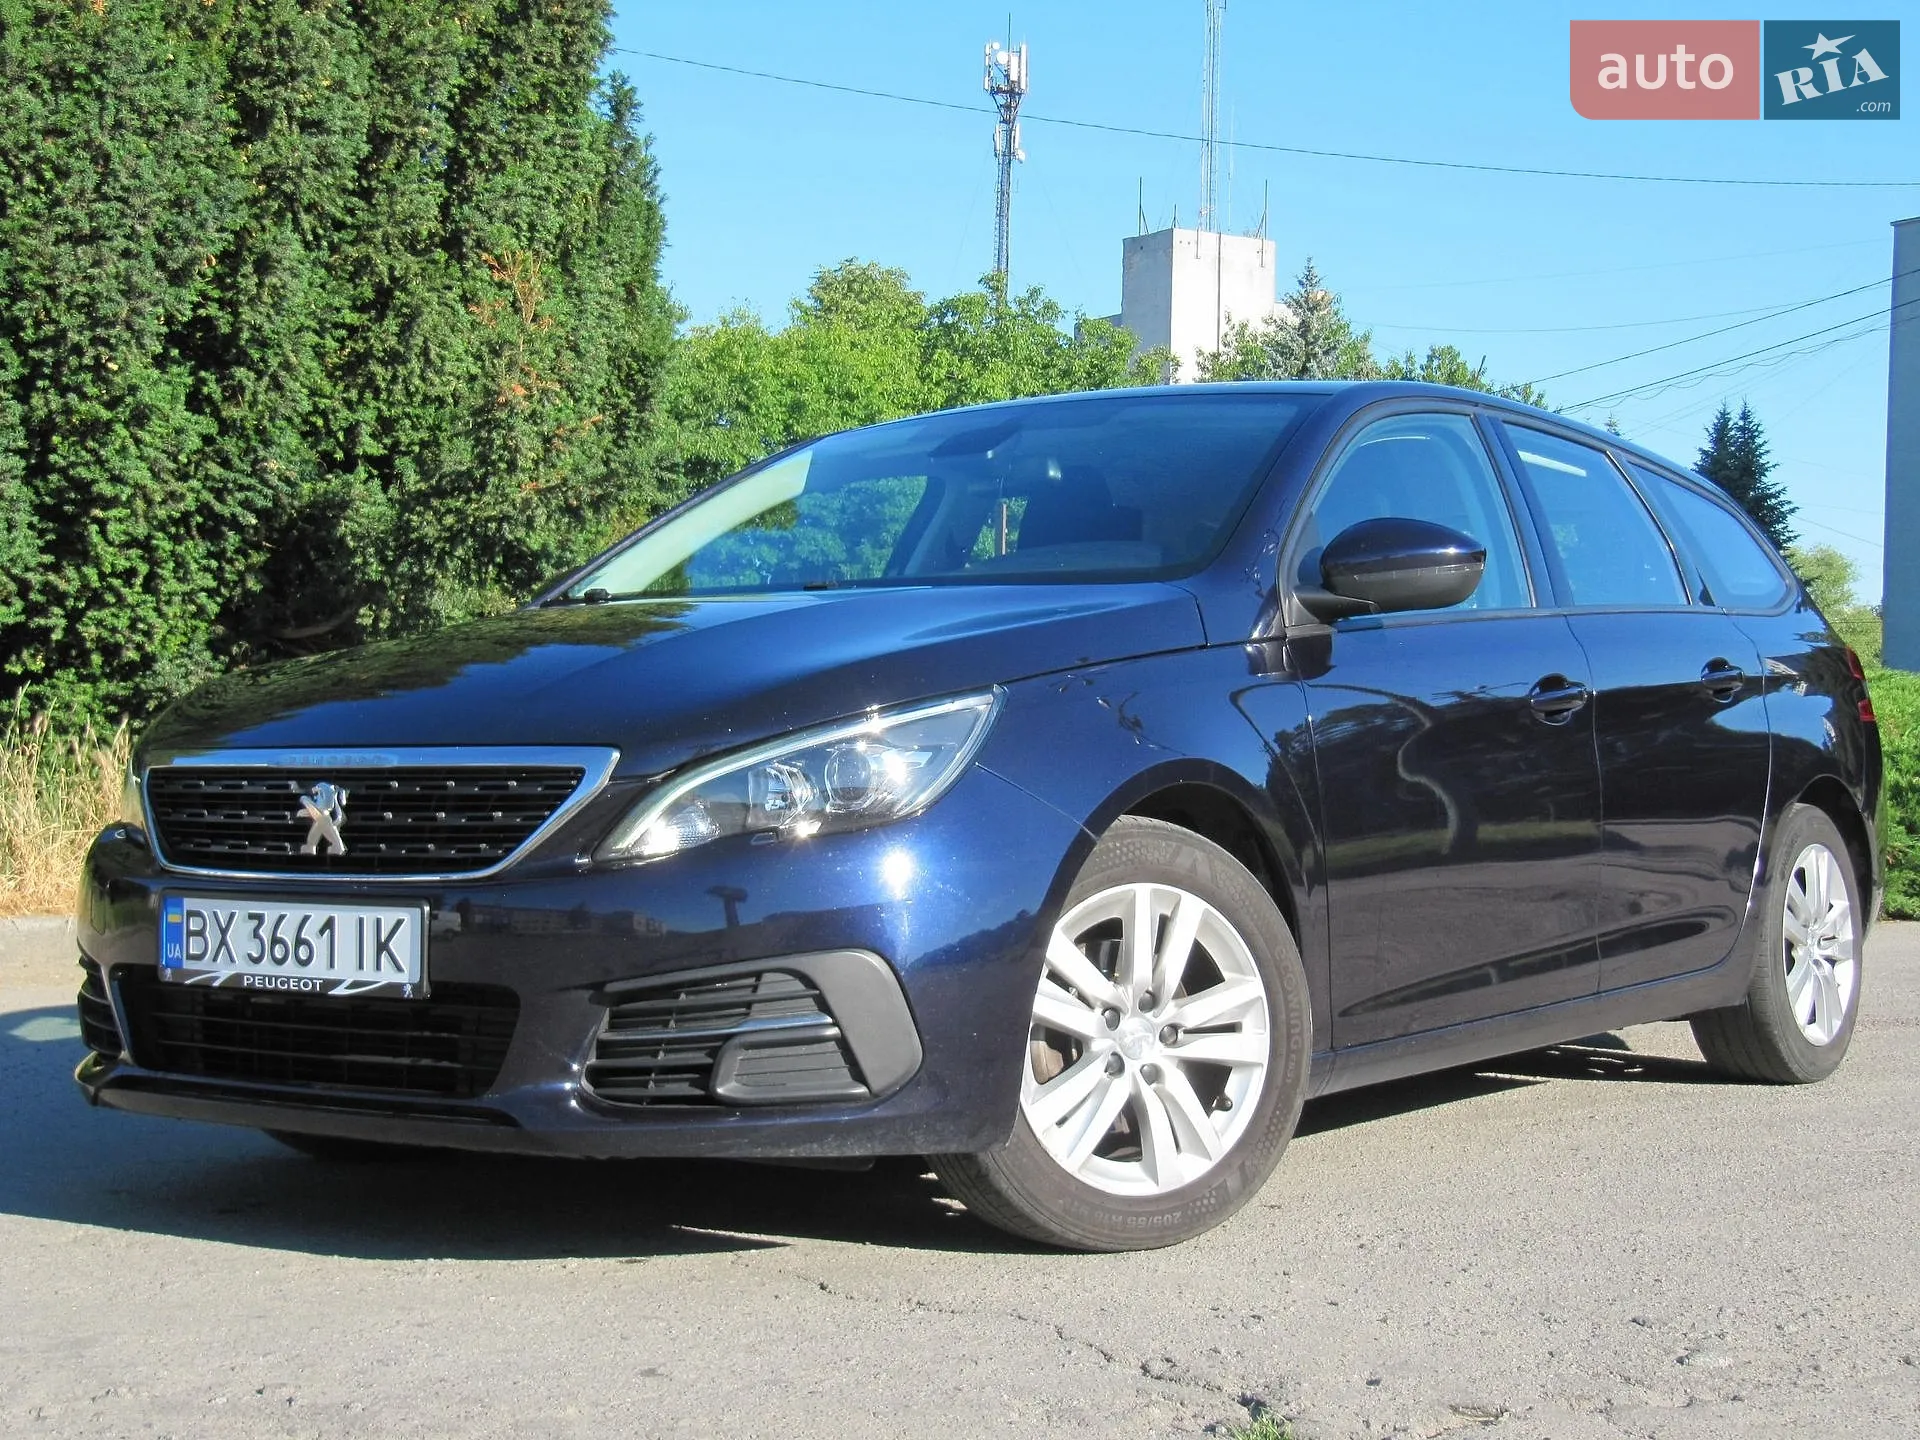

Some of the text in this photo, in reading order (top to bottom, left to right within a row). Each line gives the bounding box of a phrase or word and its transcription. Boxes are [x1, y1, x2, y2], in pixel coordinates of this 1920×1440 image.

[185, 909, 409, 974] BX 3661 IK
[167, 943, 182, 960] UA
[243, 974, 323, 992] PEUGEOT
